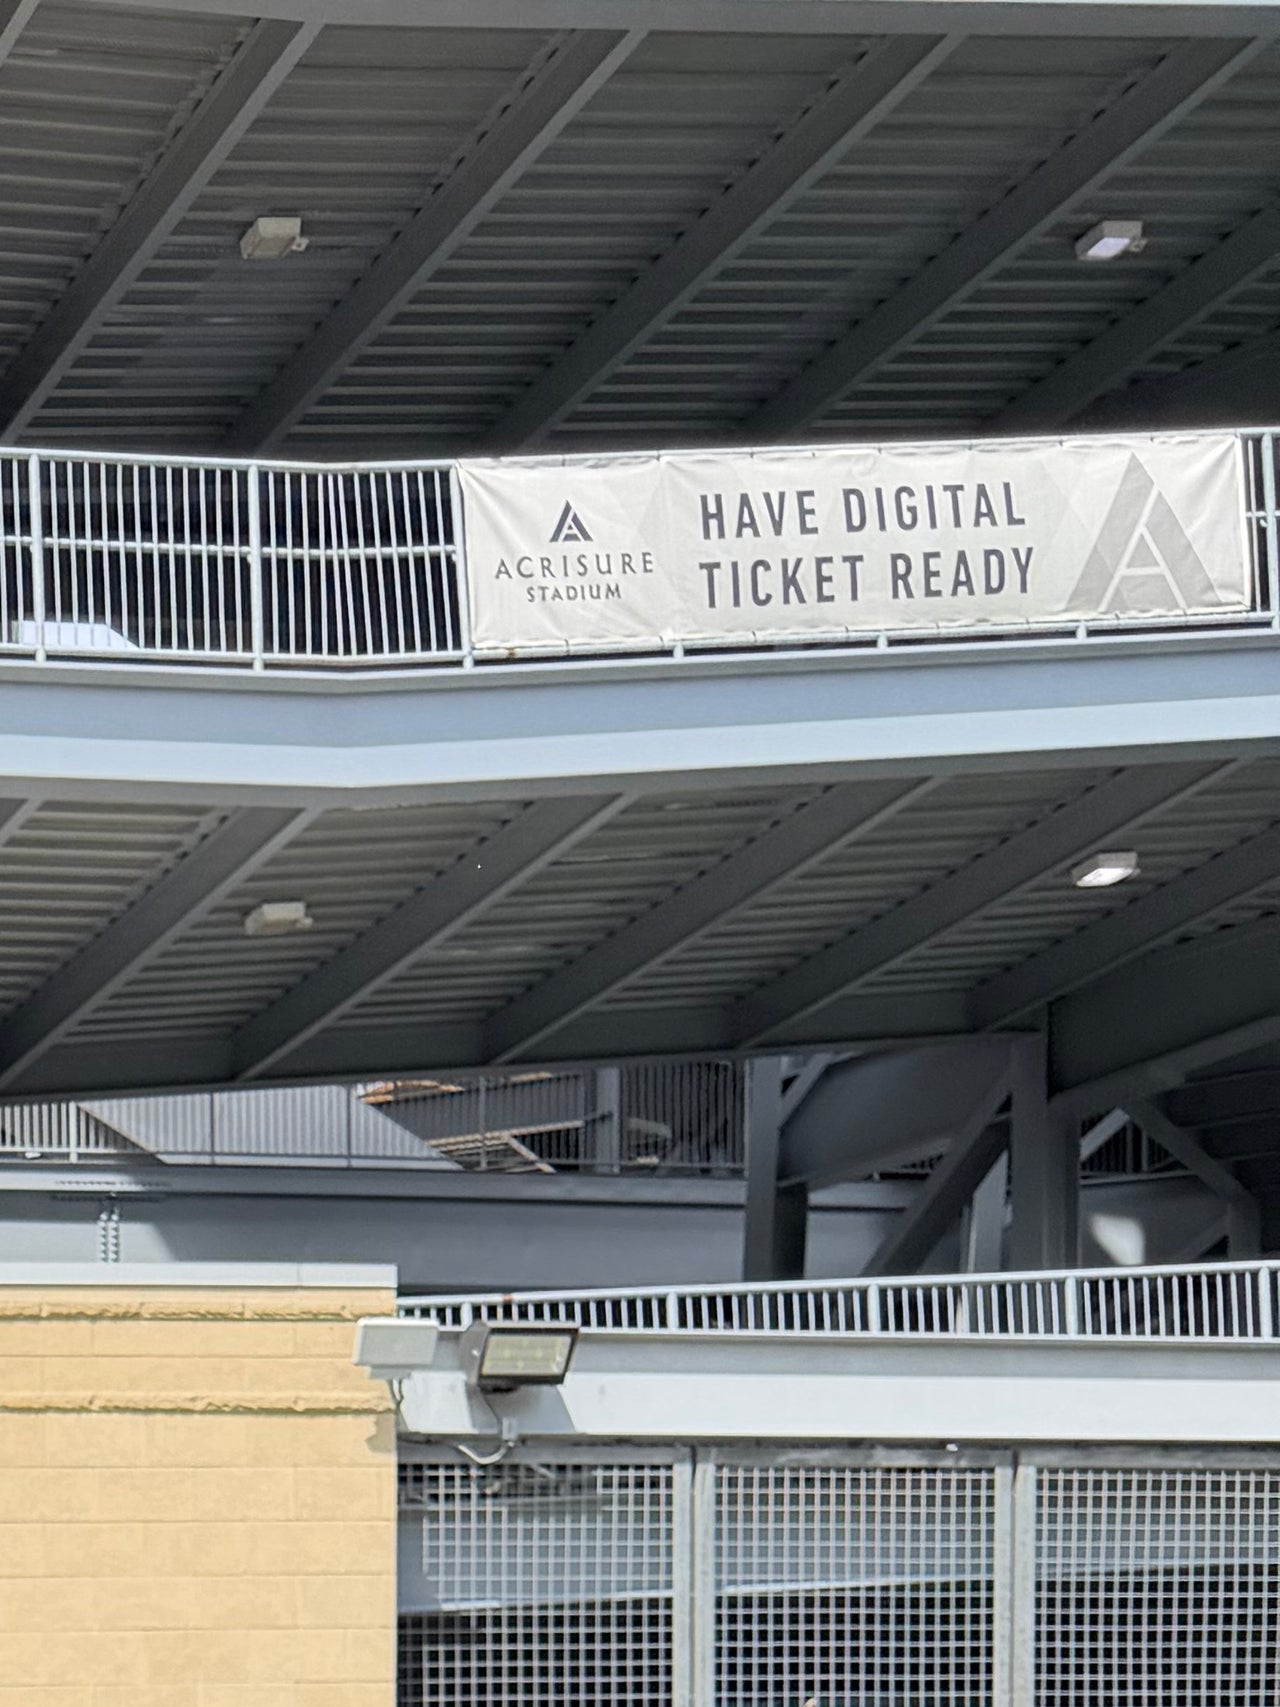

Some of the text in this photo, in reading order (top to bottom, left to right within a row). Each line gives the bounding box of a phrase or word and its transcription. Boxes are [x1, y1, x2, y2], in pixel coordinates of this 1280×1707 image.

[700, 481, 1026, 540] HAVE DIGITAL
[495, 552, 654, 579] ACRISURE
[699, 547, 1034, 608] TICKET READY
[526, 583, 622, 602] STADIUM
